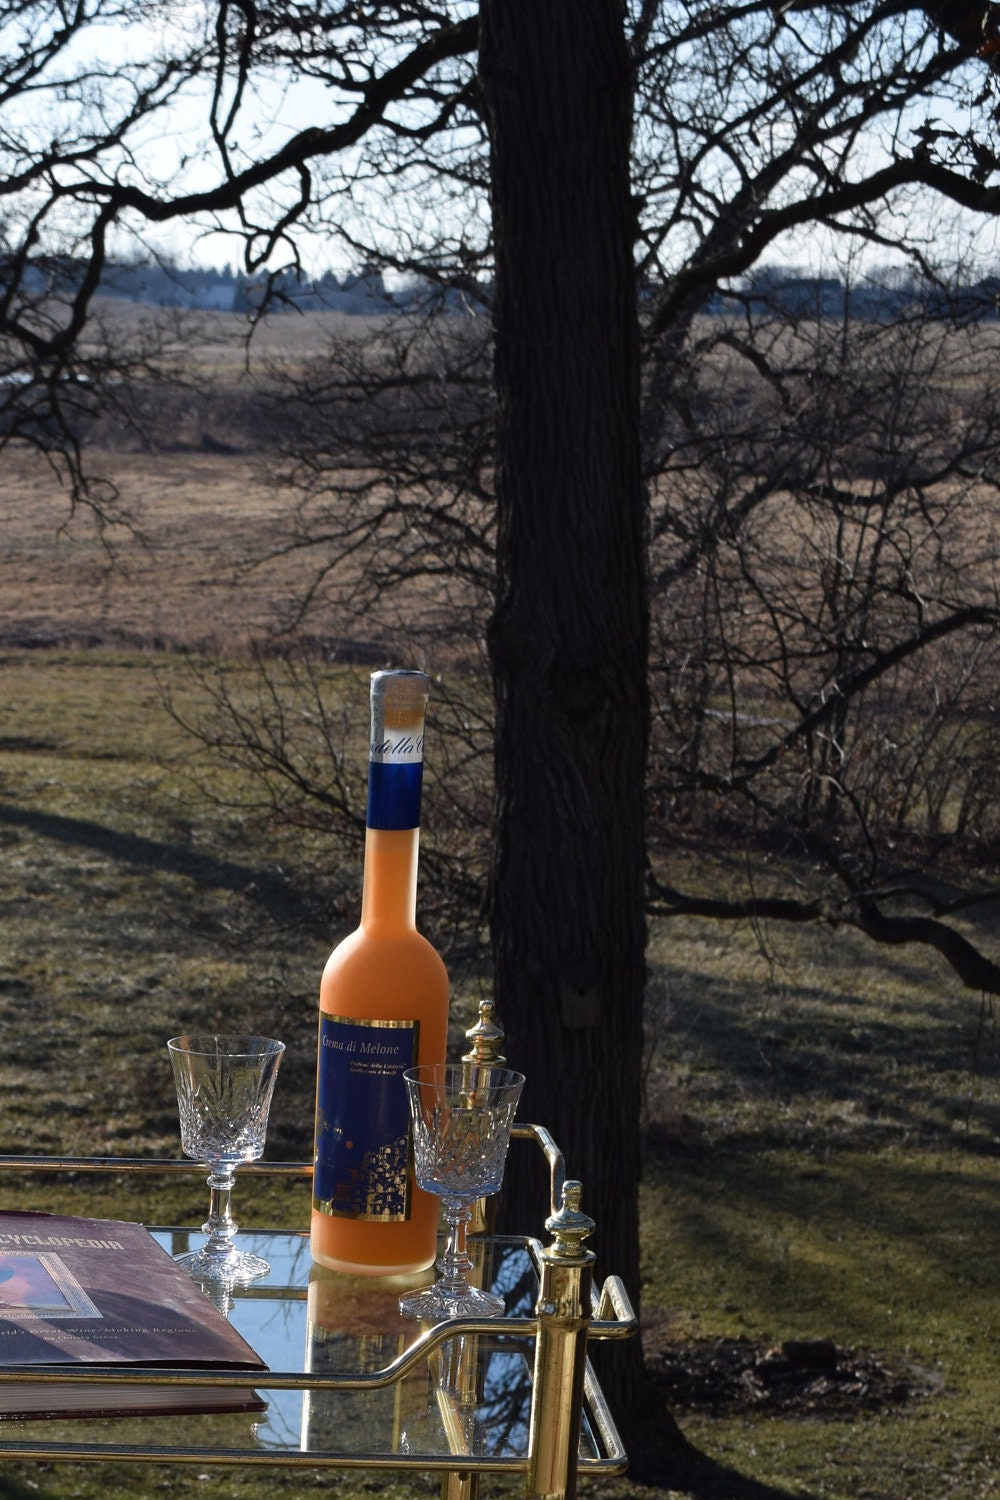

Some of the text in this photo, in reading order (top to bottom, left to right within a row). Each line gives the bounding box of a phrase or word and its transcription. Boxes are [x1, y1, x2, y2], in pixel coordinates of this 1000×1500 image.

[322, 1034, 400, 1055] Crema di Melone
